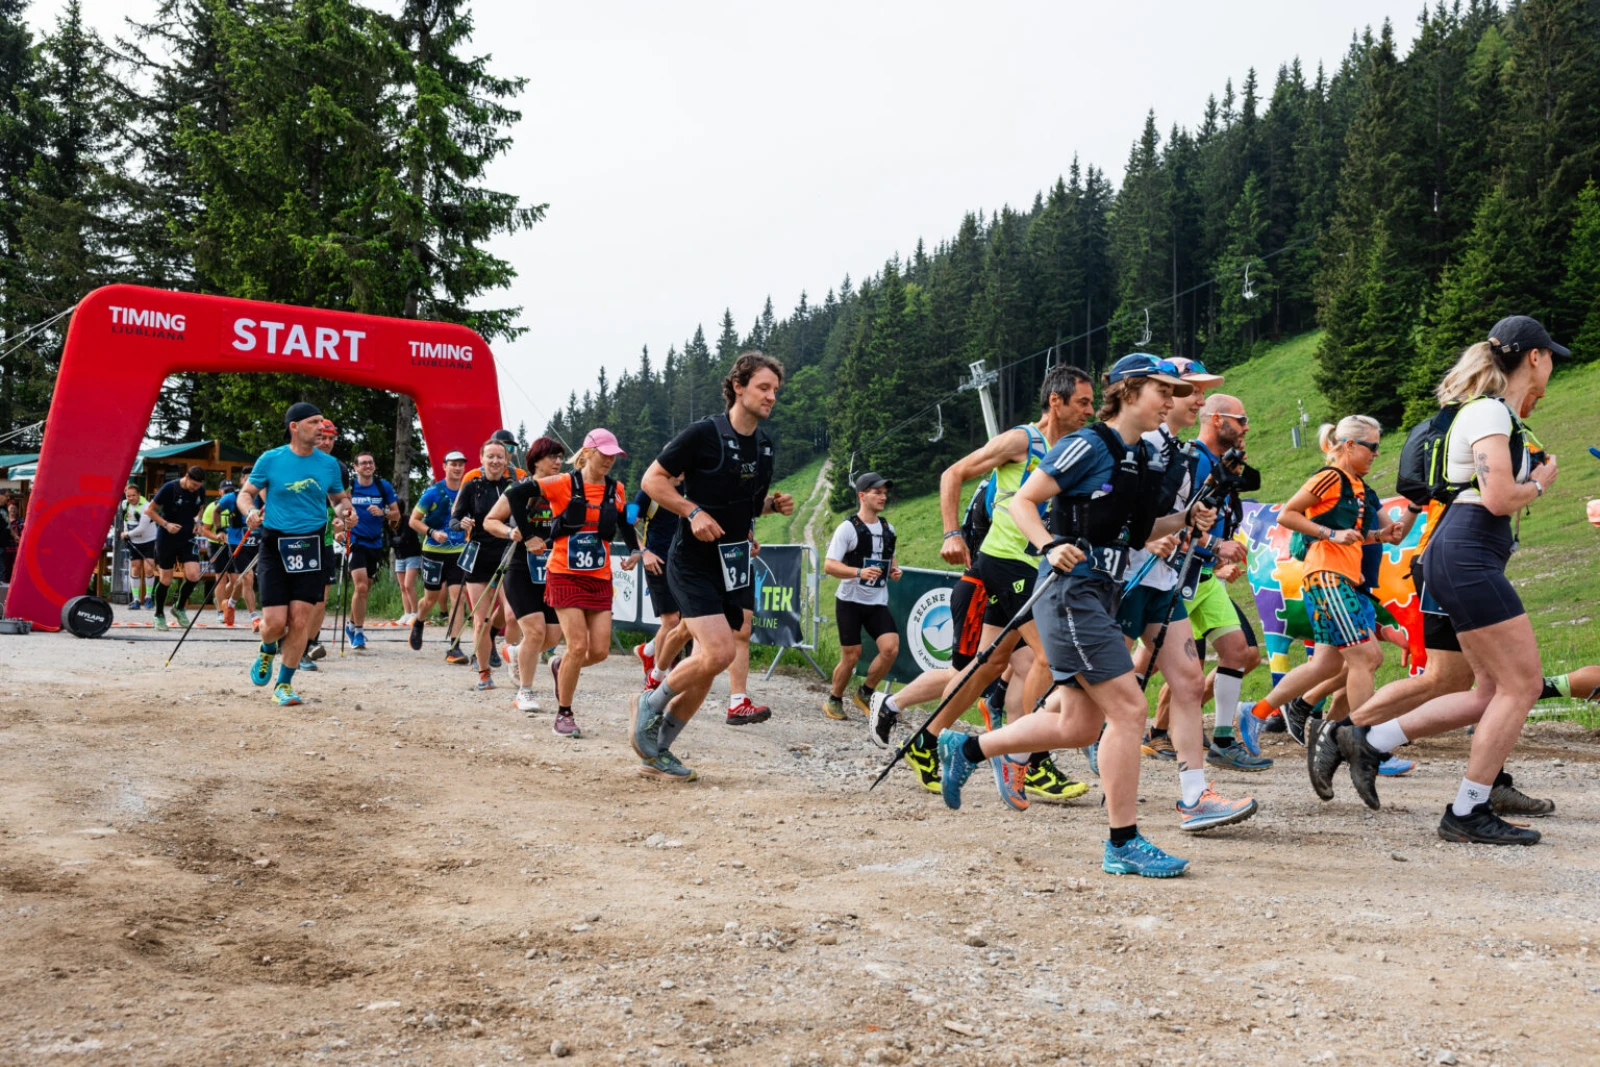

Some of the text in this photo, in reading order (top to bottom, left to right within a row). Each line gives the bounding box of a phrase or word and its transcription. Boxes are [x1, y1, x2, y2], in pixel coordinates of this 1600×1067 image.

[108, 305, 186, 331] TIMING
[231, 317, 367, 362] START
[408, 341, 473, 361] TIMING
[287, 555, 304, 570] 38
[575, 551, 594, 568] 36
[1103, 547, 1121, 577] 31
[762, 586, 793, 612] TEK
[914, 593, 946, 623] ZELENE
[77, 610, 105, 622] MYLAPS
